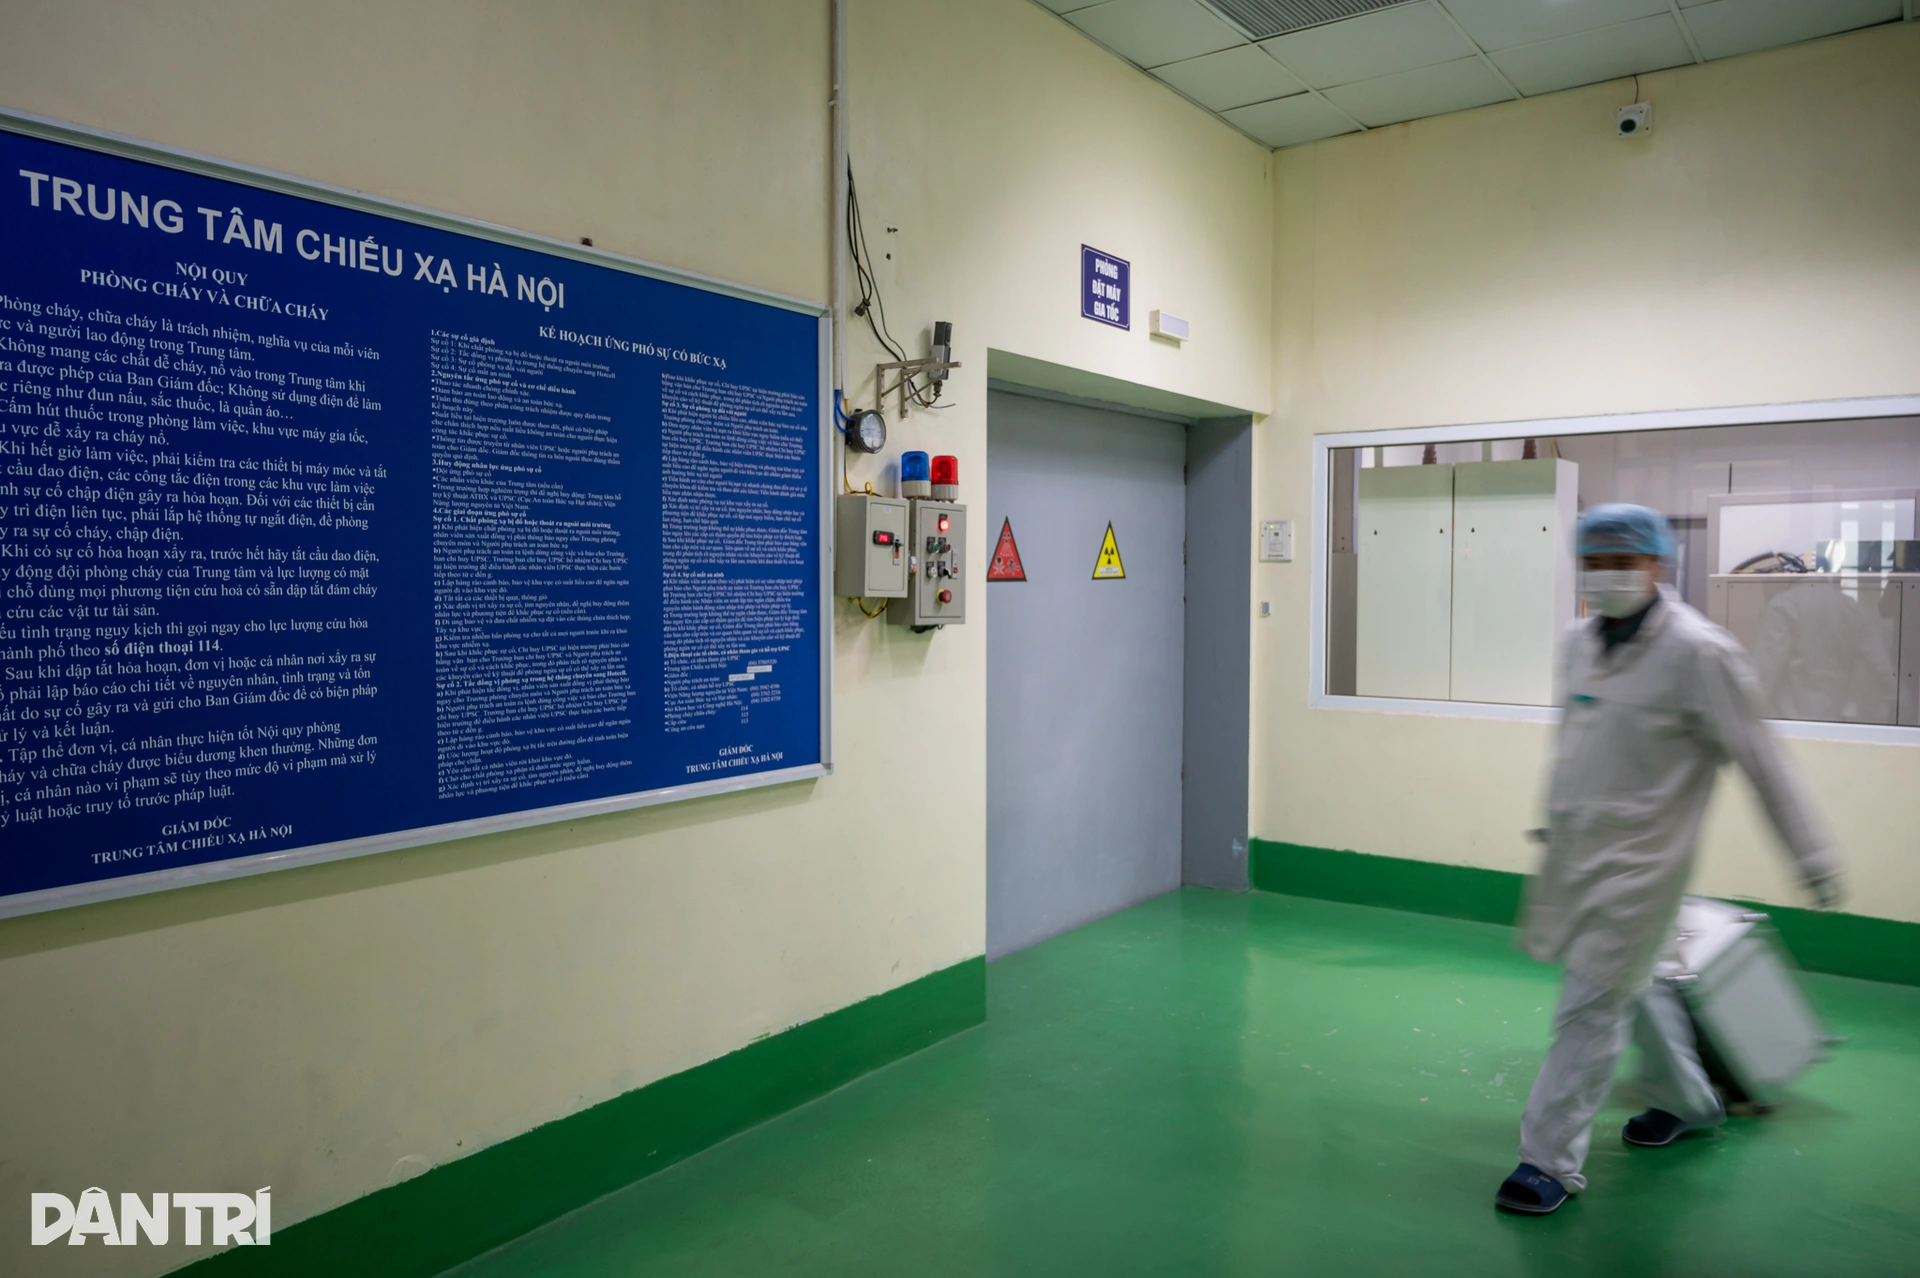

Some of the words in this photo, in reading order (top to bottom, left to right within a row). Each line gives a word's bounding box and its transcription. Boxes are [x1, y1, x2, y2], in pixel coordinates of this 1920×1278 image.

[19, 169, 184, 234] TRUNG
[197, 206, 283, 254] TÂM
[296, 229, 403, 277] CHIẾU
[413, 252, 458, 293] XẠ
[467, 262, 509, 298] HÀ
[517, 274, 564, 313] NỘI
[176, 262, 207, 281] NỘI
[212, 268, 248, 286] QUY
[1095, 258, 1118, 279] PHÒNG
[81, 269, 147, 292] PHÒNG
[152, 281, 203, 301] CHÁY
[206, 288, 230, 306] VÀ
[234, 294, 282, 314] CHỮA
[285, 303, 329, 321] CHÁY
[1092, 279, 1106, 299] ĐẶT
[1106, 284, 1121, 302] MÁY
[1094, 301, 1106, 318] GIA
[1106, 303, 1119, 322] TỐC
[16, 319, 34, 333] và
[39, 325, 81, 339] người
[86, 327, 107, 342] lao
[111, 331, 146, 350] động
[150, 337, 184, 355] trong
[187, 341, 226, 359] Trung
[229, 347, 255, 361] tâm.
[46, 302, 84, 322] cháy,
[88, 308, 121, 325] chữa
[125, 314, 157, 332] cháy
[162, 318, 173, 332] là
[177, 322, 209, 337] trách
[213, 326, 255, 344] nhiệm,
[258, 334, 290, 349] nghĩa
[294, 340, 308, 352] vụ
[311, 341, 330, 353] của
[333, 345, 354, 357] mỗi
[357, 347, 379, 360] viên
[559, 329, 602, 347] HOẠCH
[605, 335, 629, 352] ỨNG
[632, 342, 655, 356] PHÓ
[656, 347, 672, 361] SỰ
[690, 351, 711, 366] BỨC
[713, 357, 727, 370] XẠ
[50, 346, 91, 363] mang
[94, 349, 117, 363] các
[121, 349, 150, 367] chất
[153, 356, 170, 369] dễ
[173, 358, 206, 376] cháy,
[210, 361, 226, 376] nổ
[229, 366, 251, 379] vào
[255, 370, 286, 386] trong
[288, 372, 323, 390] Trung
[325, 377, 346, 390] tâm
[349, 379, 365, 392] khi
[2, 544, 28, 557] Khi
[34, 544, 51, 558] có
[56, 548, 73, 560] sự
[77, 542, 94, 558] cố
[98, 545, 123, 558] hỏa
[127, 546, 159, 561] hoạn
[191, 550, 207, 561] ra,
[210, 548, 243, 560] trước
[246, 545, 264, 560] hết
[268, 548, 288, 563] hãy
[292, 545, 306, 561] tắt
[309, 546, 328, 561] cầu
[331, 549, 351, 561] dao
[353, 550, 379, 563] điện,
[15, 564, 53, 581] động
[57, 565, 80, 580] đội
[85, 565, 128, 581] phòng
[132, 565, 163, 581] cháy
[167, 566, 190, 578] của
[193, 566, 231, 581] Trung
[234, 566, 256, 578] tâm
[260, 566, 274, 578] và
[277, 566, 295, 580] lực
[298, 566, 331, 581] lượng
[333, 566, 347, 578] có
[349, 567, 369, 580] mặt
[38, 644, 65, 662] phố
[70, 644, 100, 657] theo
[105, 639, 120, 656] số
[124, 641, 154, 657] điện
[159, 640, 193, 656] thoại
[199, 639, 223, 652] 114.
[5, 667, 33, 680] Sau
[38, 664, 60, 678] khi
[65, 664, 91, 680] dập
[96, 659, 113, 675] tắt
[117, 662, 141, 674] hỏa
[146, 660, 181, 672] hoạn,
[185, 658, 209, 671] đơn
[213, 657, 224, 672] vị
[228, 657, 257, 670] hoặc
[260, 655, 273, 667] cá
[276, 654, 304, 666] nhân
[307, 652, 325, 664] nơi
[351, 654, 362, 662] ra
[364, 653, 377, 663] sự
[8, 748, 37, 763] Tập
[42, 744, 64, 759] thể
[68, 743, 95, 756] đơn
[100, 739, 117, 755] vị,
[121, 738, 137, 751] cá
[141, 735, 172, 749] nhân
[176, 733, 204, 746] thực
[208, 730, 234, 744] hiện
[238, 725, 253, 740] tốt
[257, 725, 278, 740] Nội
[282, 726, 303, 739] quy
[307, 721, 341, 737] phòng
[719, 745, 738, 757] GIÁM
[686, 762, 711, 774] TRUNG
[712, 759, 727, 770] TÂM
[750, 756, 760, 765] XẠ
[760, 752, 771, 762] HÀ
[771, 751, 783, 761] NỘI
[15, 807, 43, 823] luật
[48, 804, 81, 818] hoặc
[86, 802, 113, 814] truy
[118, 795, 131, 809] tố
[135, 792, 170, 807] trước
[174, 788, 205, 806] pháp
[209, 784, 235, 799] luật.
[162, 820, 199, 836] GIÁM
[91, 847, 143, 864] TRUNG
[146, 841, 178, 856] TÂM
[228, 832, 245, 844] XẠ
[249, 826, 267, 841] HÀ
[270, 824, 292, 838] NỘI
